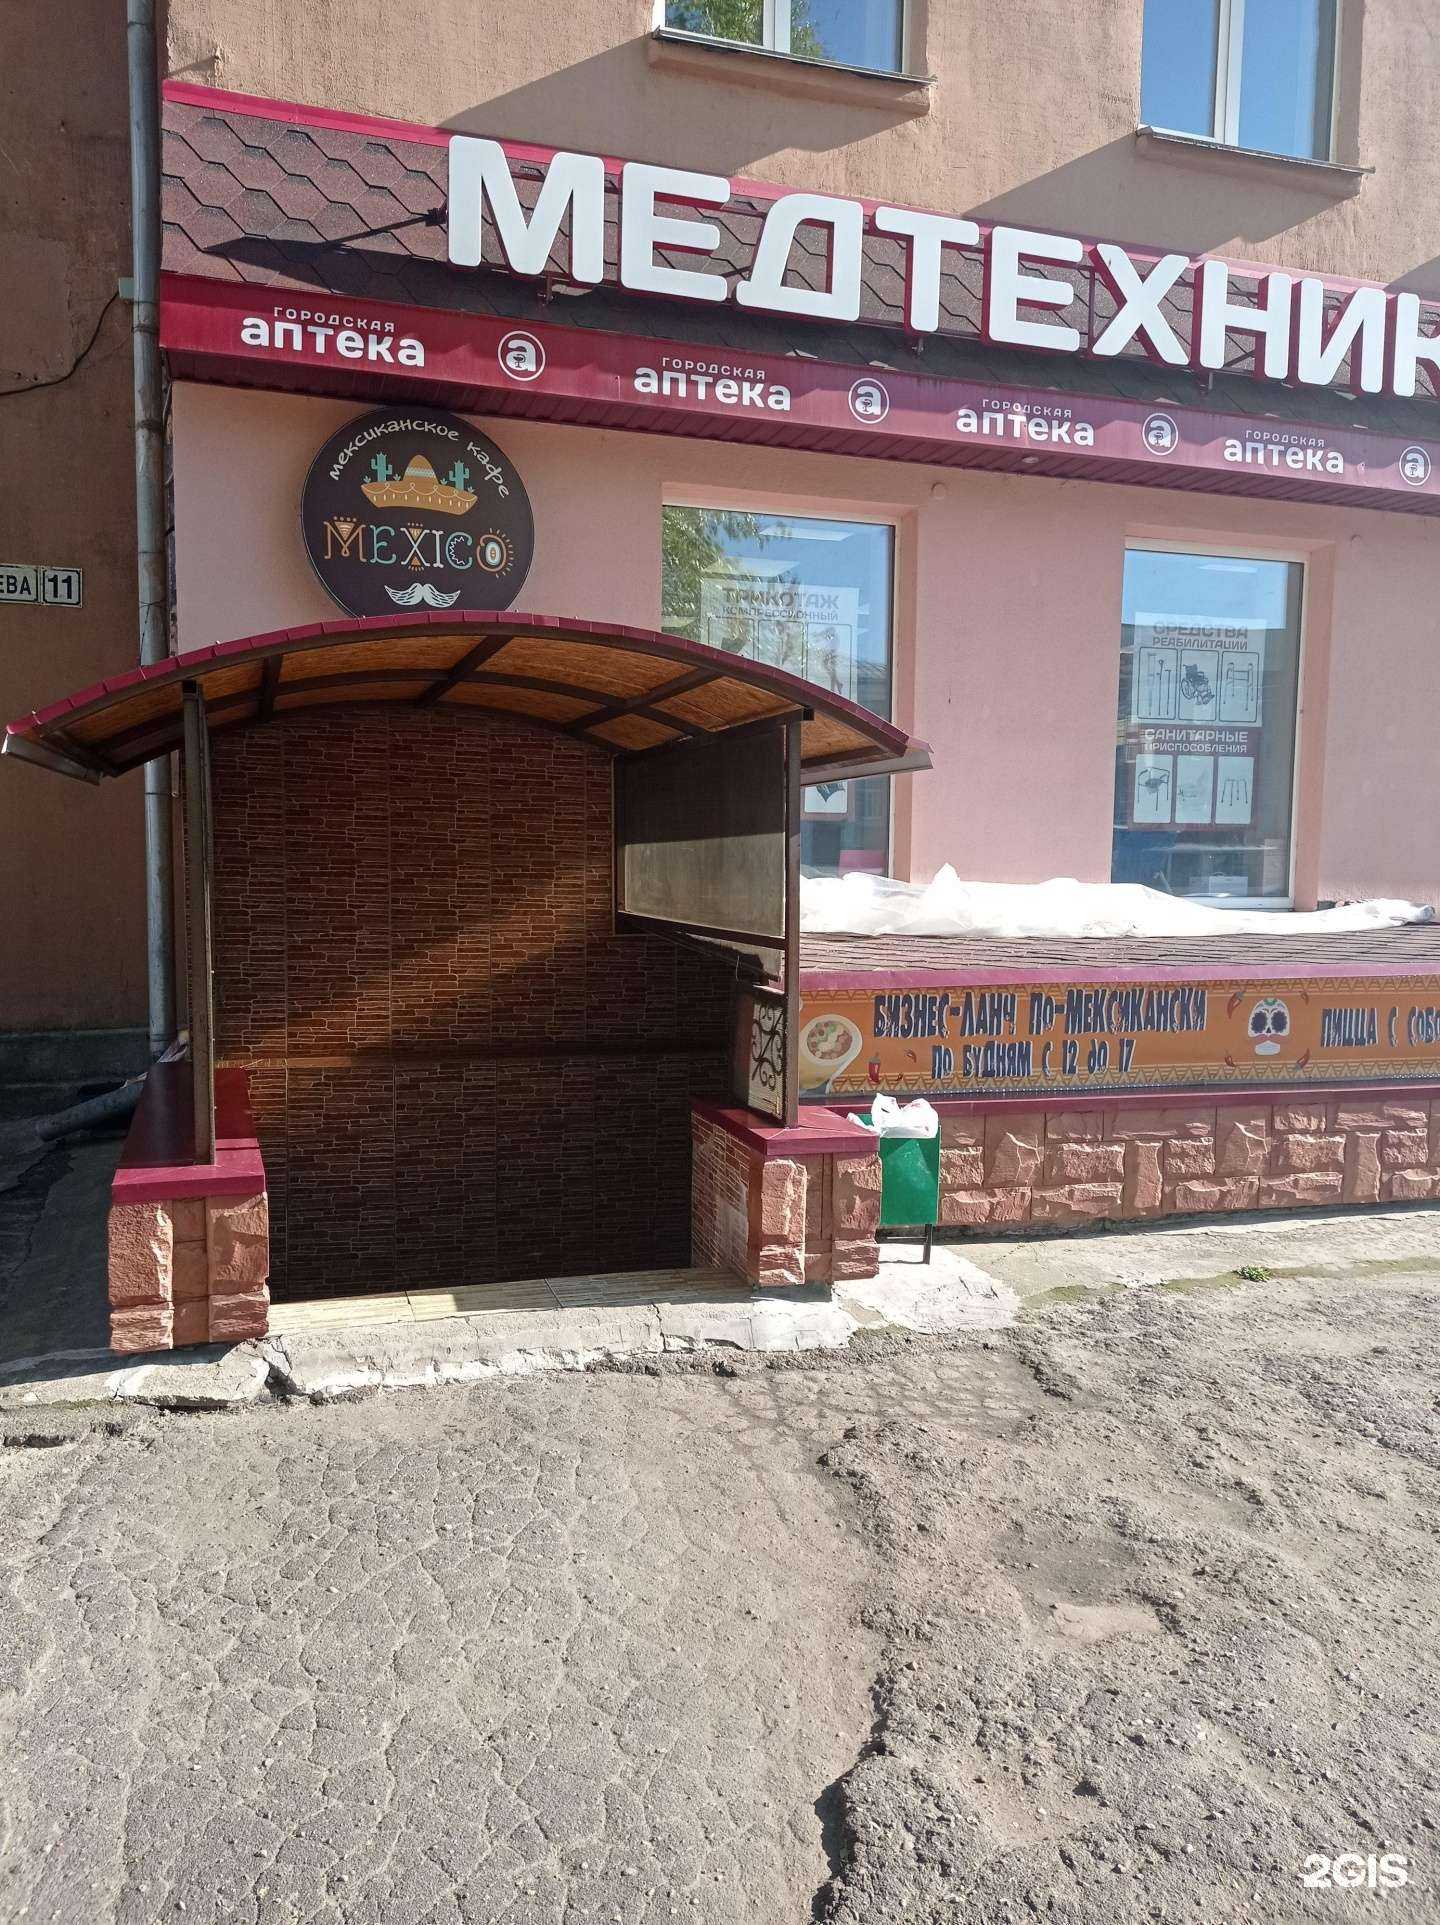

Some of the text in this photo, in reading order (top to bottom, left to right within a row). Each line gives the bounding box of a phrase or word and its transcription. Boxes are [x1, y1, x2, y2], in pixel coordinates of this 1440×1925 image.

[273, 306, 395, 333] ГОРОДСКАЯ
[240, 316, 425, 367] аптека
[662, 356, 766, 380] ГОРОДСКАЯ
[633, 366, 791, 411] аптека
[982, 399, 1072, 419] ГОРОДСКАЯ
[956, 408, 1095, 447] аптека
[1245, 430, 1325, 448] ГОРОДСКАЯ
[329, 418, 510, 499] мексиканское кафе
[1223, 438, 1344, 474] аптека
[323, 517, 512, 576] MEXICO
[47, 574, 73, 600] 11
[1152, 622, 1249, 639] СРЕДСТВА
[1152, 636, 1248, 651] РЕАБИЛИТАЦИИ
[1144, 728, 1249, 743] САНИТАРНЫЕ
[1144, 741, 1248, 753] ПРИСПОСОБЛЕНИЯ
[874, 991, 1017, 1038] БИЗНЕС-ЛАНЧ
[1320, 1008, 1379, 1048] ПИЦЦА
[963, 1040, 1033, 1078] БУДНЯМ
[1062, 1039, 1080, 1075] 12
[1118, 1038, 1136, 1073] 17
